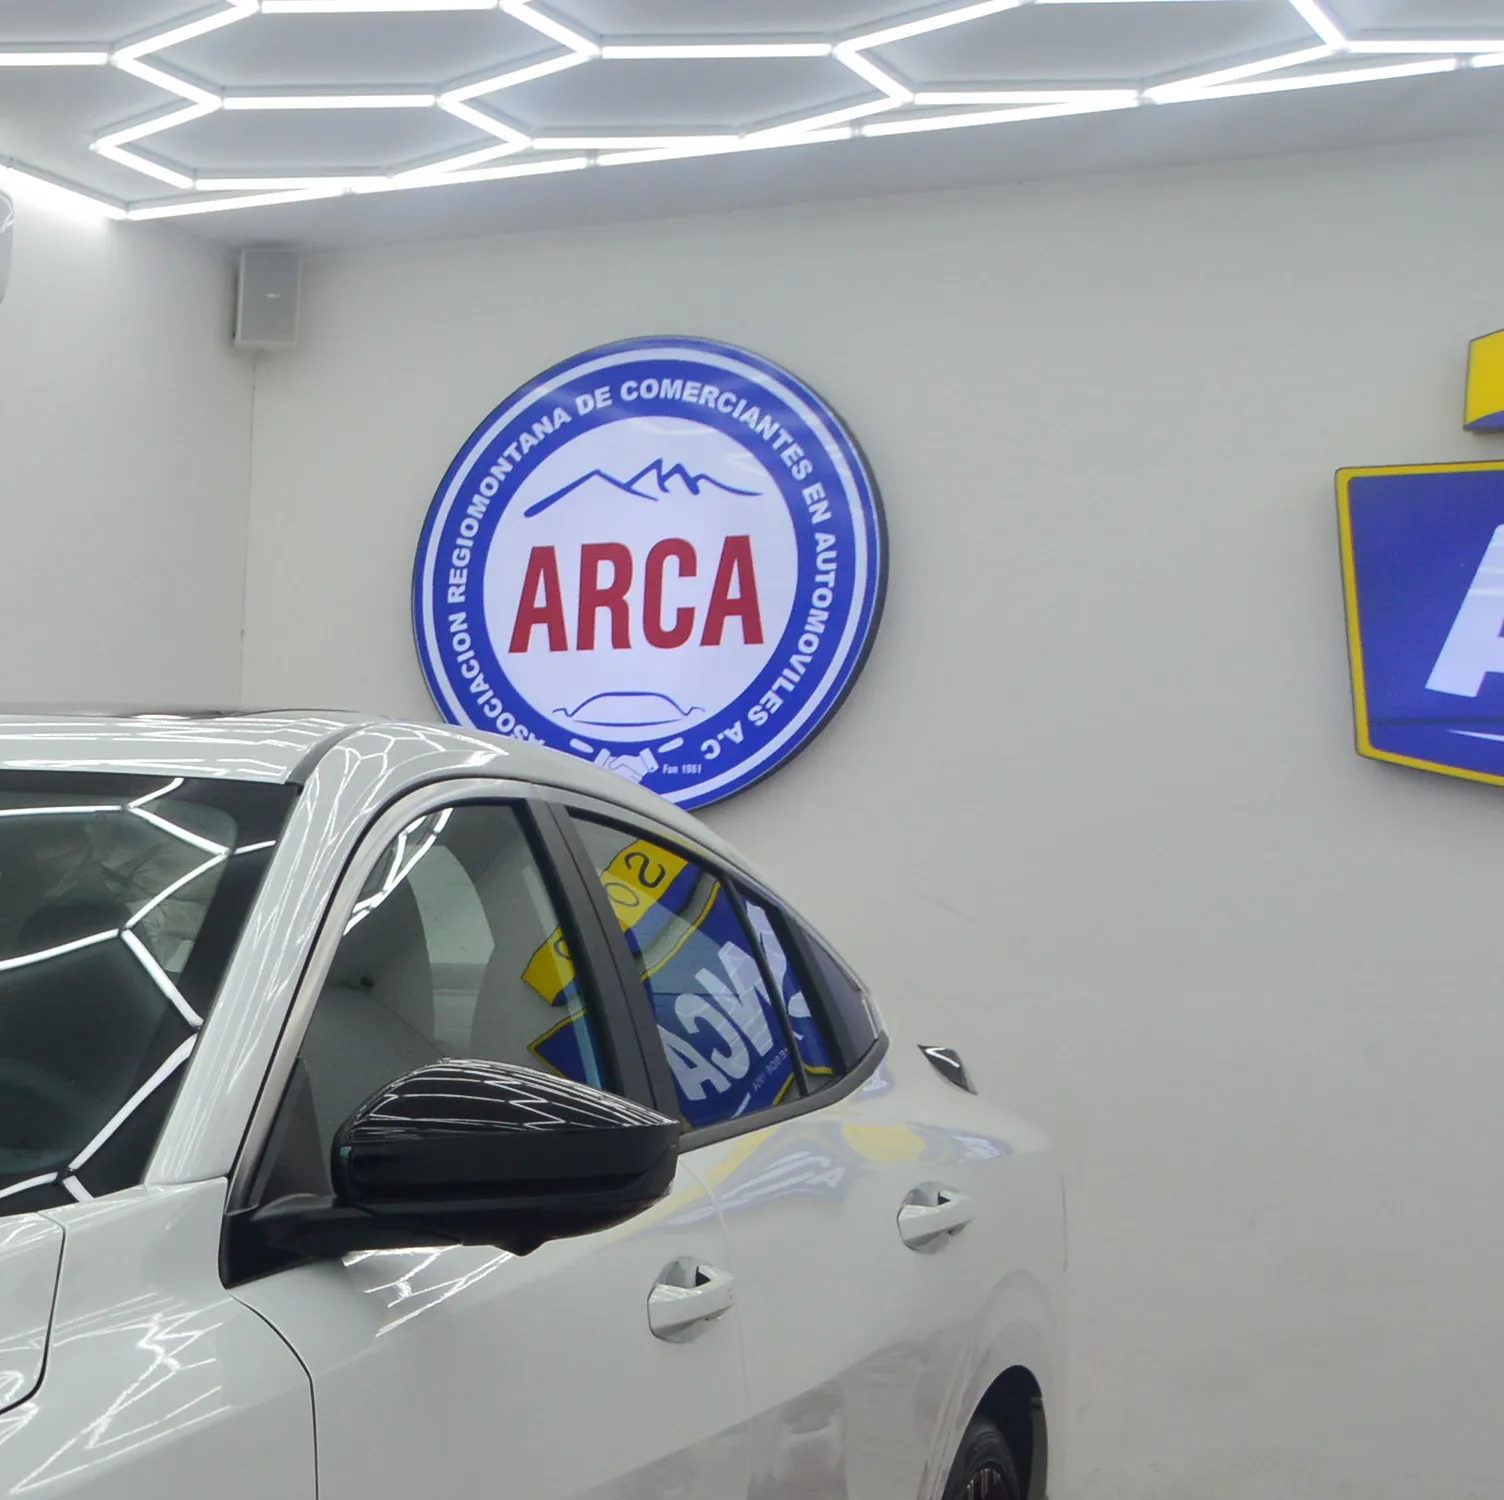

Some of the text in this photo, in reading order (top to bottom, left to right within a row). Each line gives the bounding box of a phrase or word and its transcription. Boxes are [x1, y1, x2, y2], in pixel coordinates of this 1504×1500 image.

[575, 385, 613, 415] DE
[620, 377, 814, 482] COMERCIANTES
[447, 406, 572, 604] REGIOMONTANA
[801, 483, 832, 526] EN
[507, 535, 765, 654] ARCA
[748, 531, 837, 727] AUTOMOVILES
